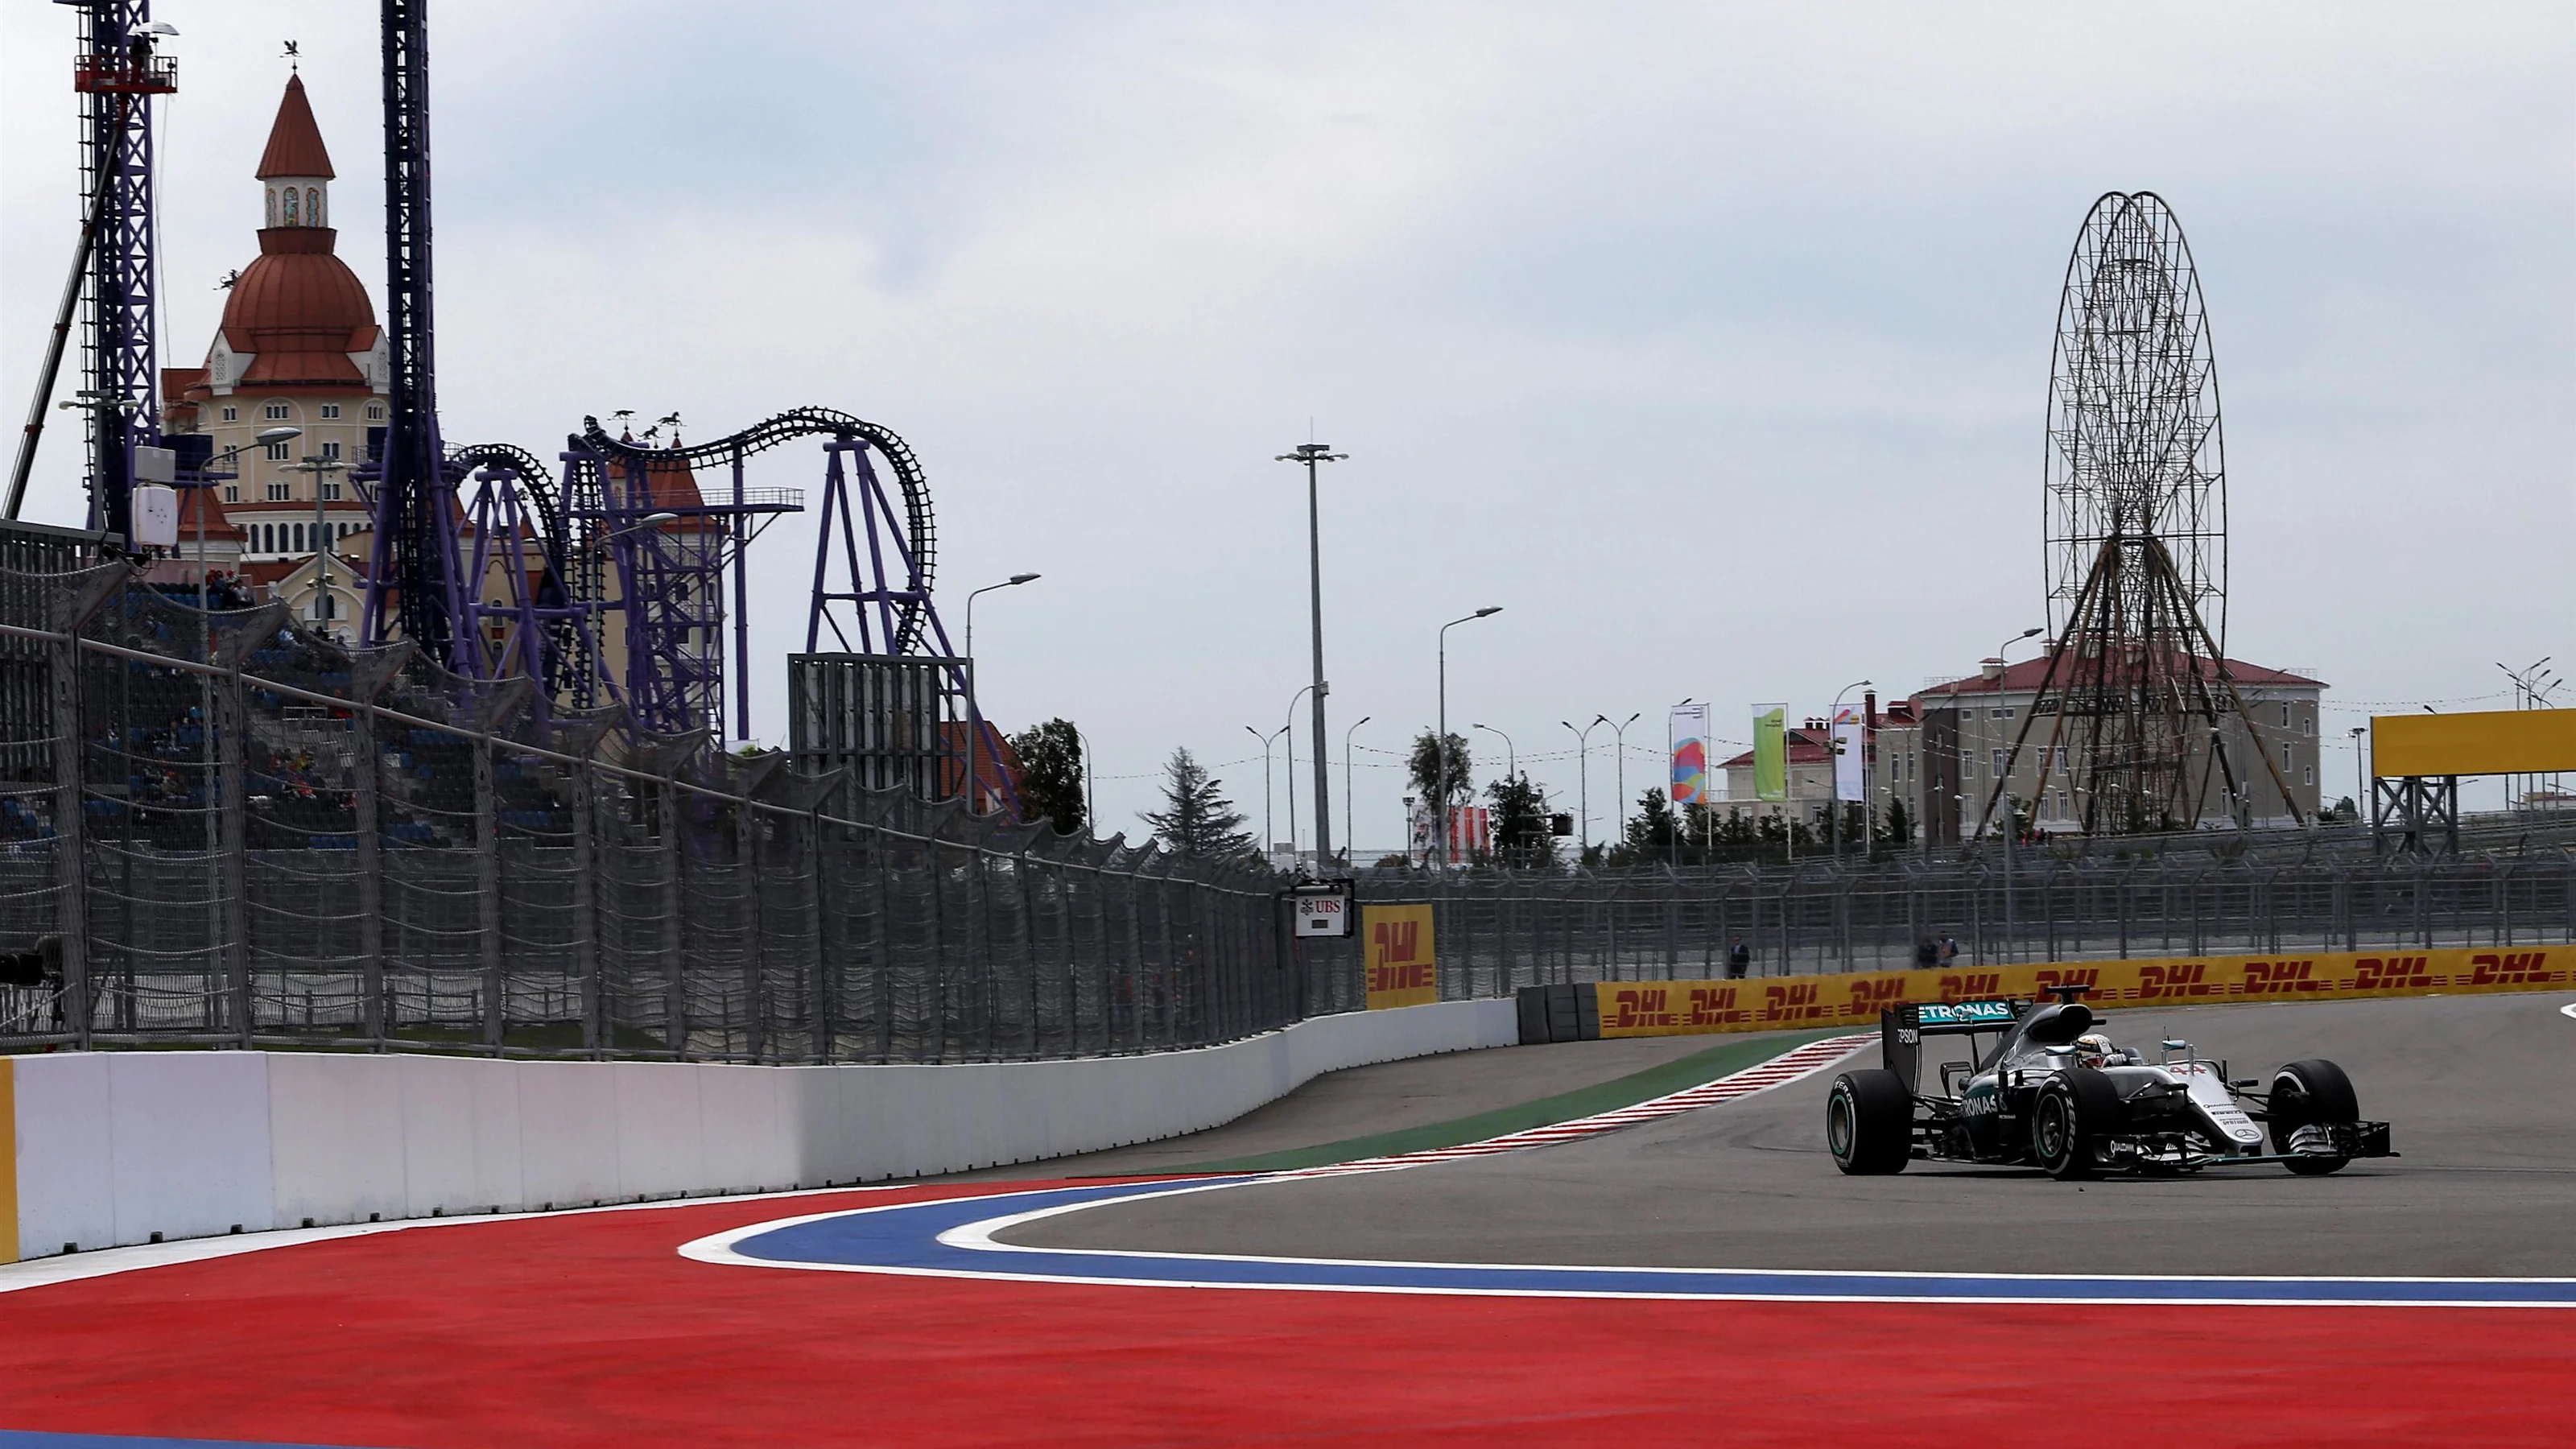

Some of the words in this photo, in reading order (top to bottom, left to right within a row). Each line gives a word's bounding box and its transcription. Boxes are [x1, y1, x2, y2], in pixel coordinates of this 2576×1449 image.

[1315, 900, 1340, 913] UBS
[1375, 921, 1423, 991] DHL
[2471, 952, 2552, 985] DHL
[1939, 974, 2004, 1005] DHL
[2035, 969, 2103, 1003] DHL
[2139, 964, 2211, 999] DHL
[2244, 961, 2319, 993] DHL
[2354, 957, 2433, 989] DHL
[1616, 990, 1671, 1027] DHL
[1690, 988, 1740, 1025] DHL
[1765, 984, 1822, 1021] DHL
[1850, 977, 1909, 1015] DHL
[1919, 1003, 2009, 1019] ETRONAS
[1835, 1081, 1853, 1103] ZERO
[1962, 1094, 1998, 1117] TRONAS
[2065, 1096, 2076, 1152] ZERO
